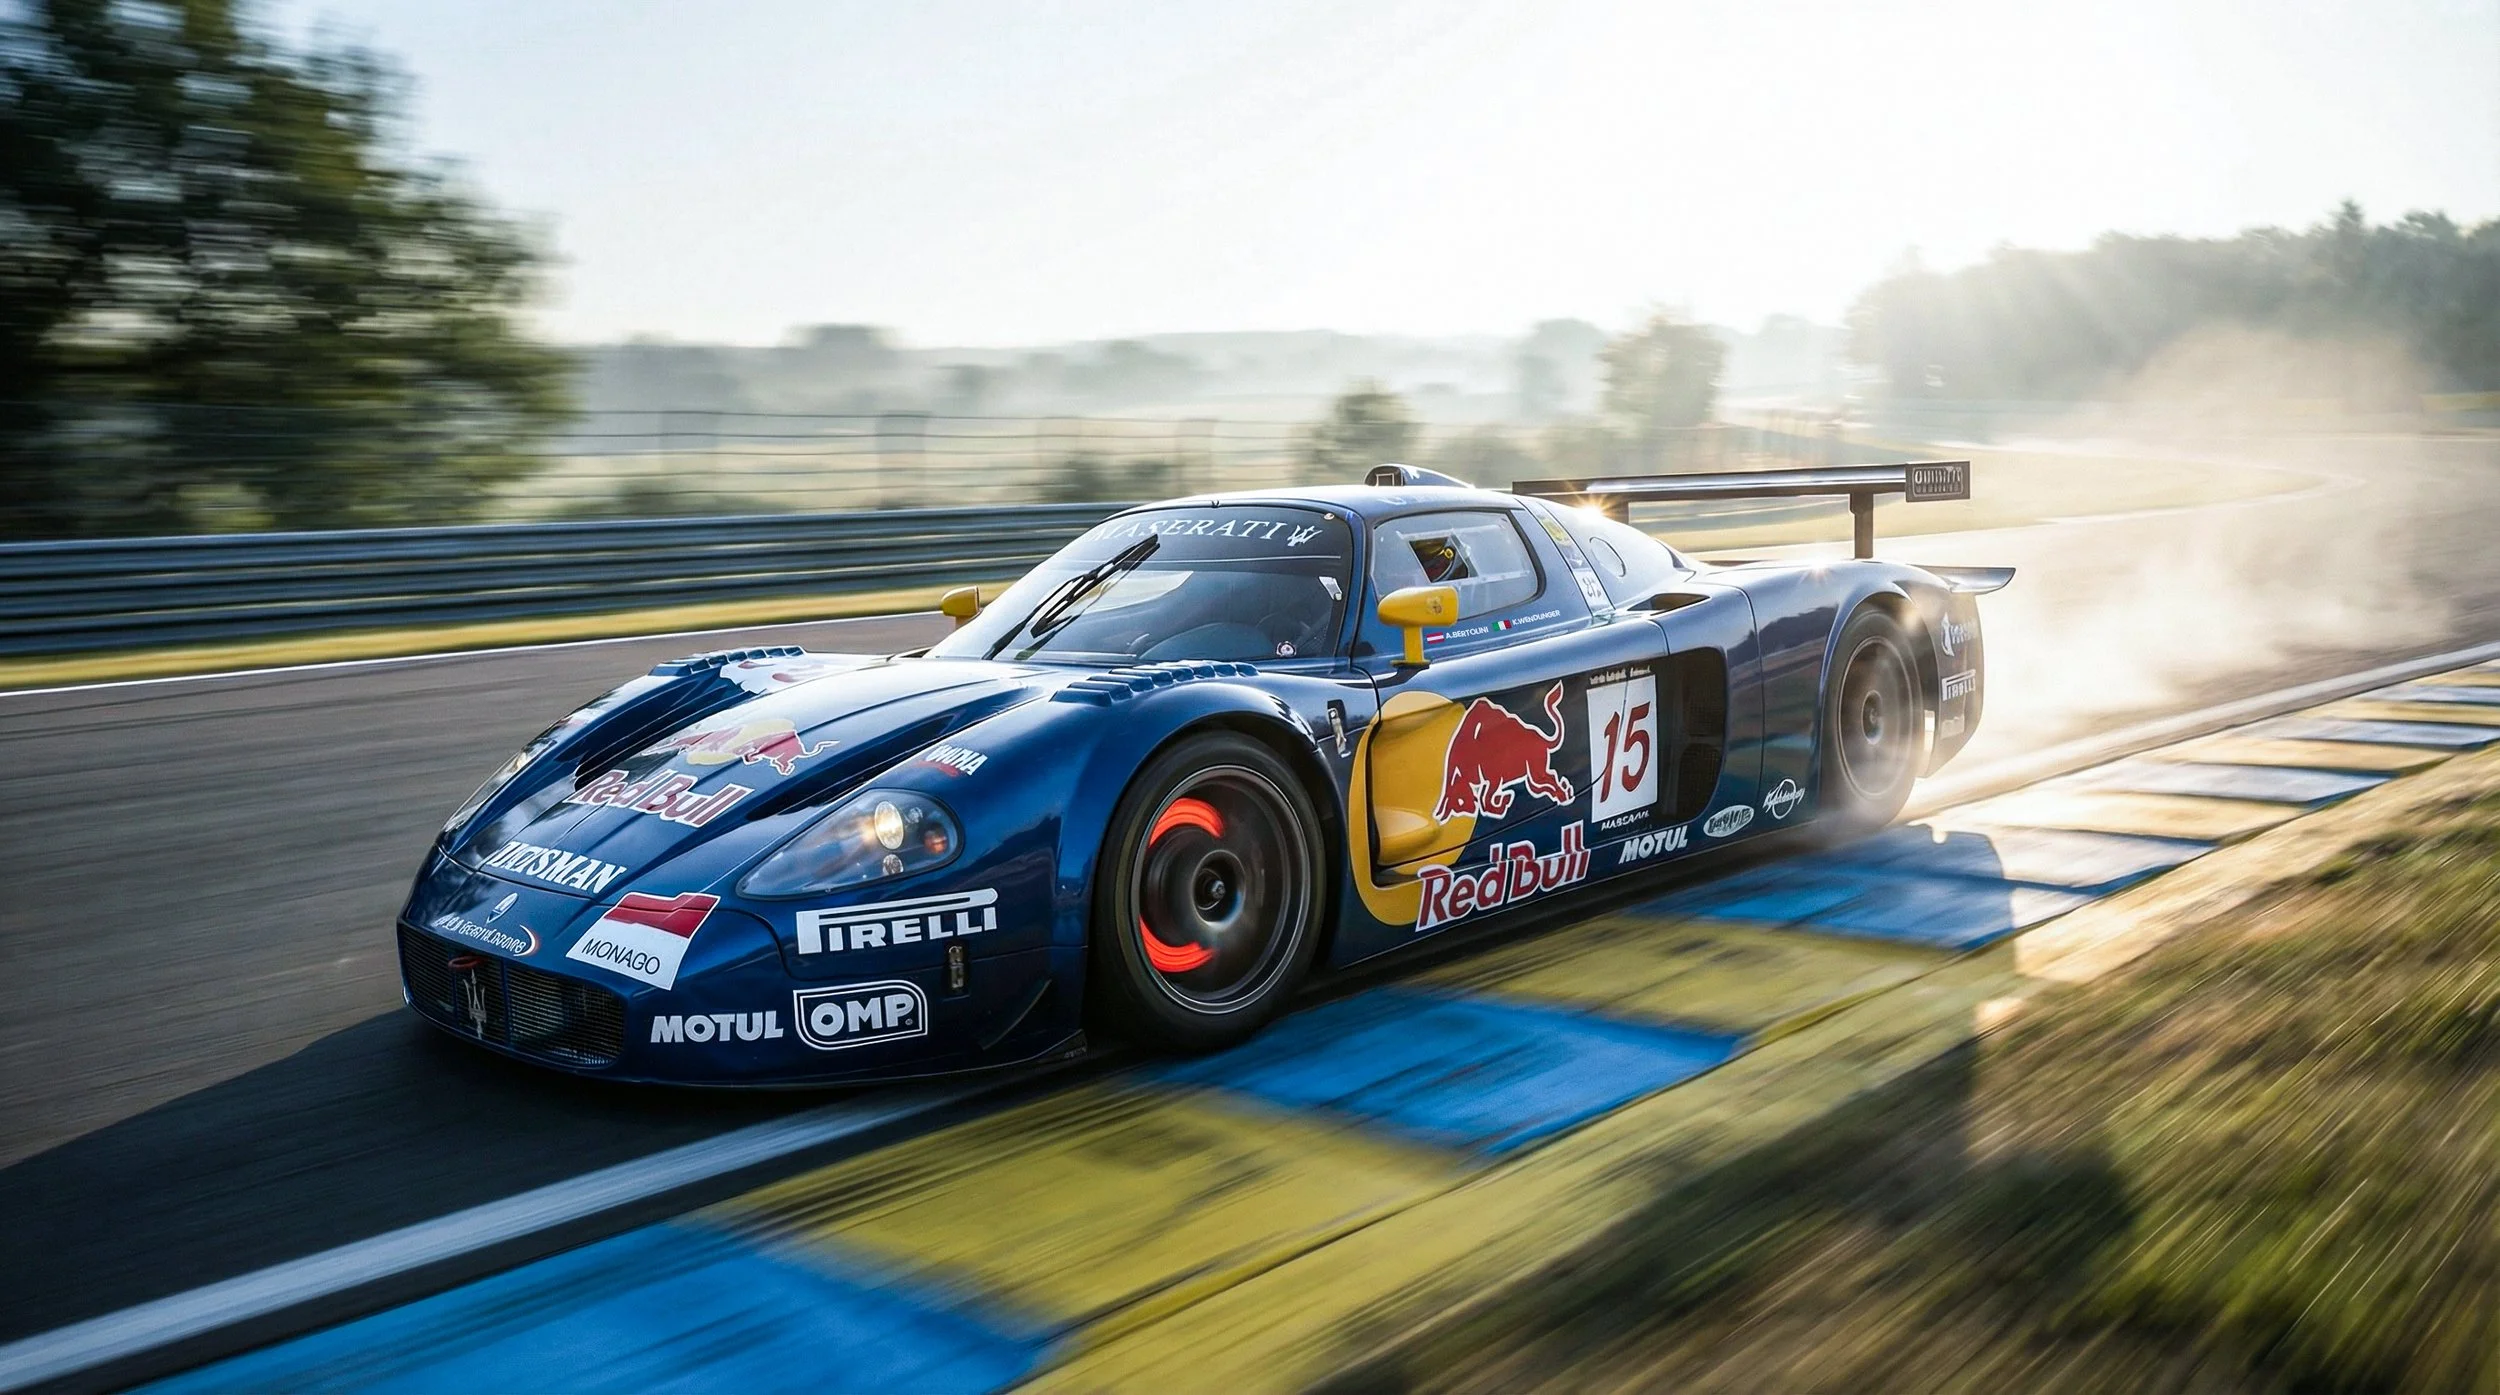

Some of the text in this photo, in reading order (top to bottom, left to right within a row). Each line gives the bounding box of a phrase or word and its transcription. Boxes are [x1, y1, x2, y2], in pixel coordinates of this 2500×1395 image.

[1600, 701, 1650, 803] 15
[563, 769, 755, 828] Red Bull
[1618, 825, 1688, 864] MOTUL
[1415, 820, 1591, 932] Red Bull
[796, 888, 998, 954] PIRELLI
[581, 938, 660, 975] MONAGO
[650, 1010, 784, 1043] MOTUL
[810, 994, 915, 1037] OMP
